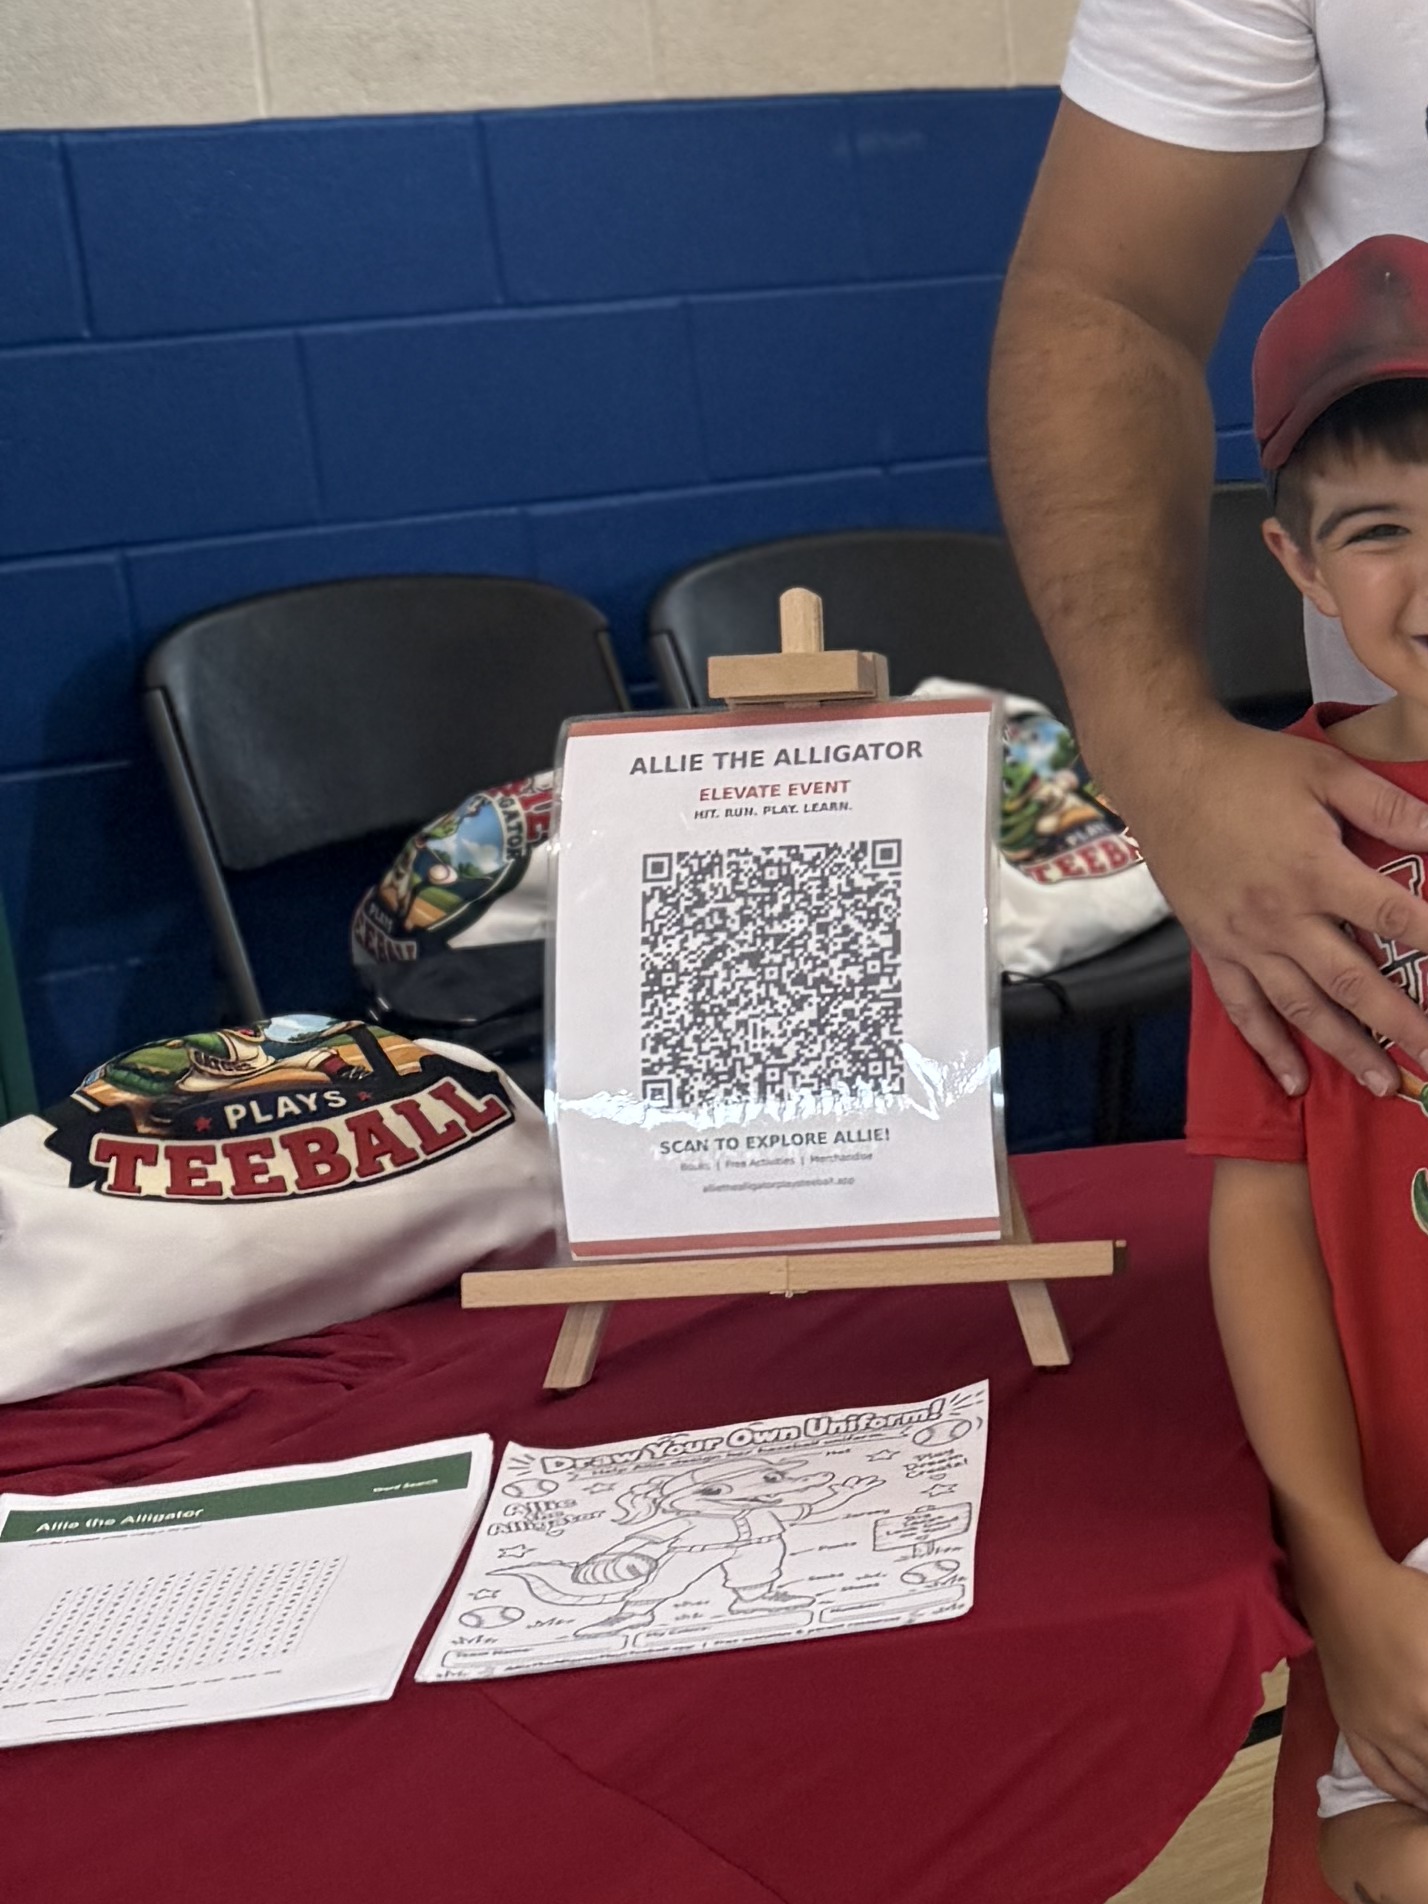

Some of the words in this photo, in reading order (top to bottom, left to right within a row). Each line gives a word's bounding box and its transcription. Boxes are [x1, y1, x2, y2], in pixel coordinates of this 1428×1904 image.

[629, 753, 704, 776] ALLIE
[713, 749, 765, 770] THE
[773, 740, 924, 767] ALLIGATOR
[699, 783, 781, 802] ELEVATE
[788, 779, 852, 797] EVENT
[694, 809, 720, 820] HIT.
[724, 807, 758, 818] RUN.
[763, 805, 799, 816] PLAY.
[804, 801, 853, 813] LEARN.
[223, 1089, 348, 1131] PLAYS
[94, 1078, 510, 1197] TEEBALL
[660, 1138, 709, 1155] SCAN
[714, 1137, 740, 1151] TO
[746, 1131, 828, 1150] EXPLORE
[833, 1128, 890, 1144] ALLIE!
[541, 1447, 641, 1474] Draw
[643, 1437, 725, 1459] Your
[726, 1426, 801, 1448] Own
[803, 1398, 946, 1438] Uniform!
[35, 1520, 80, 1534] Allie
[86, 1517, 116, 1529] the
[120, 1508, 204, 1526] Alligator
